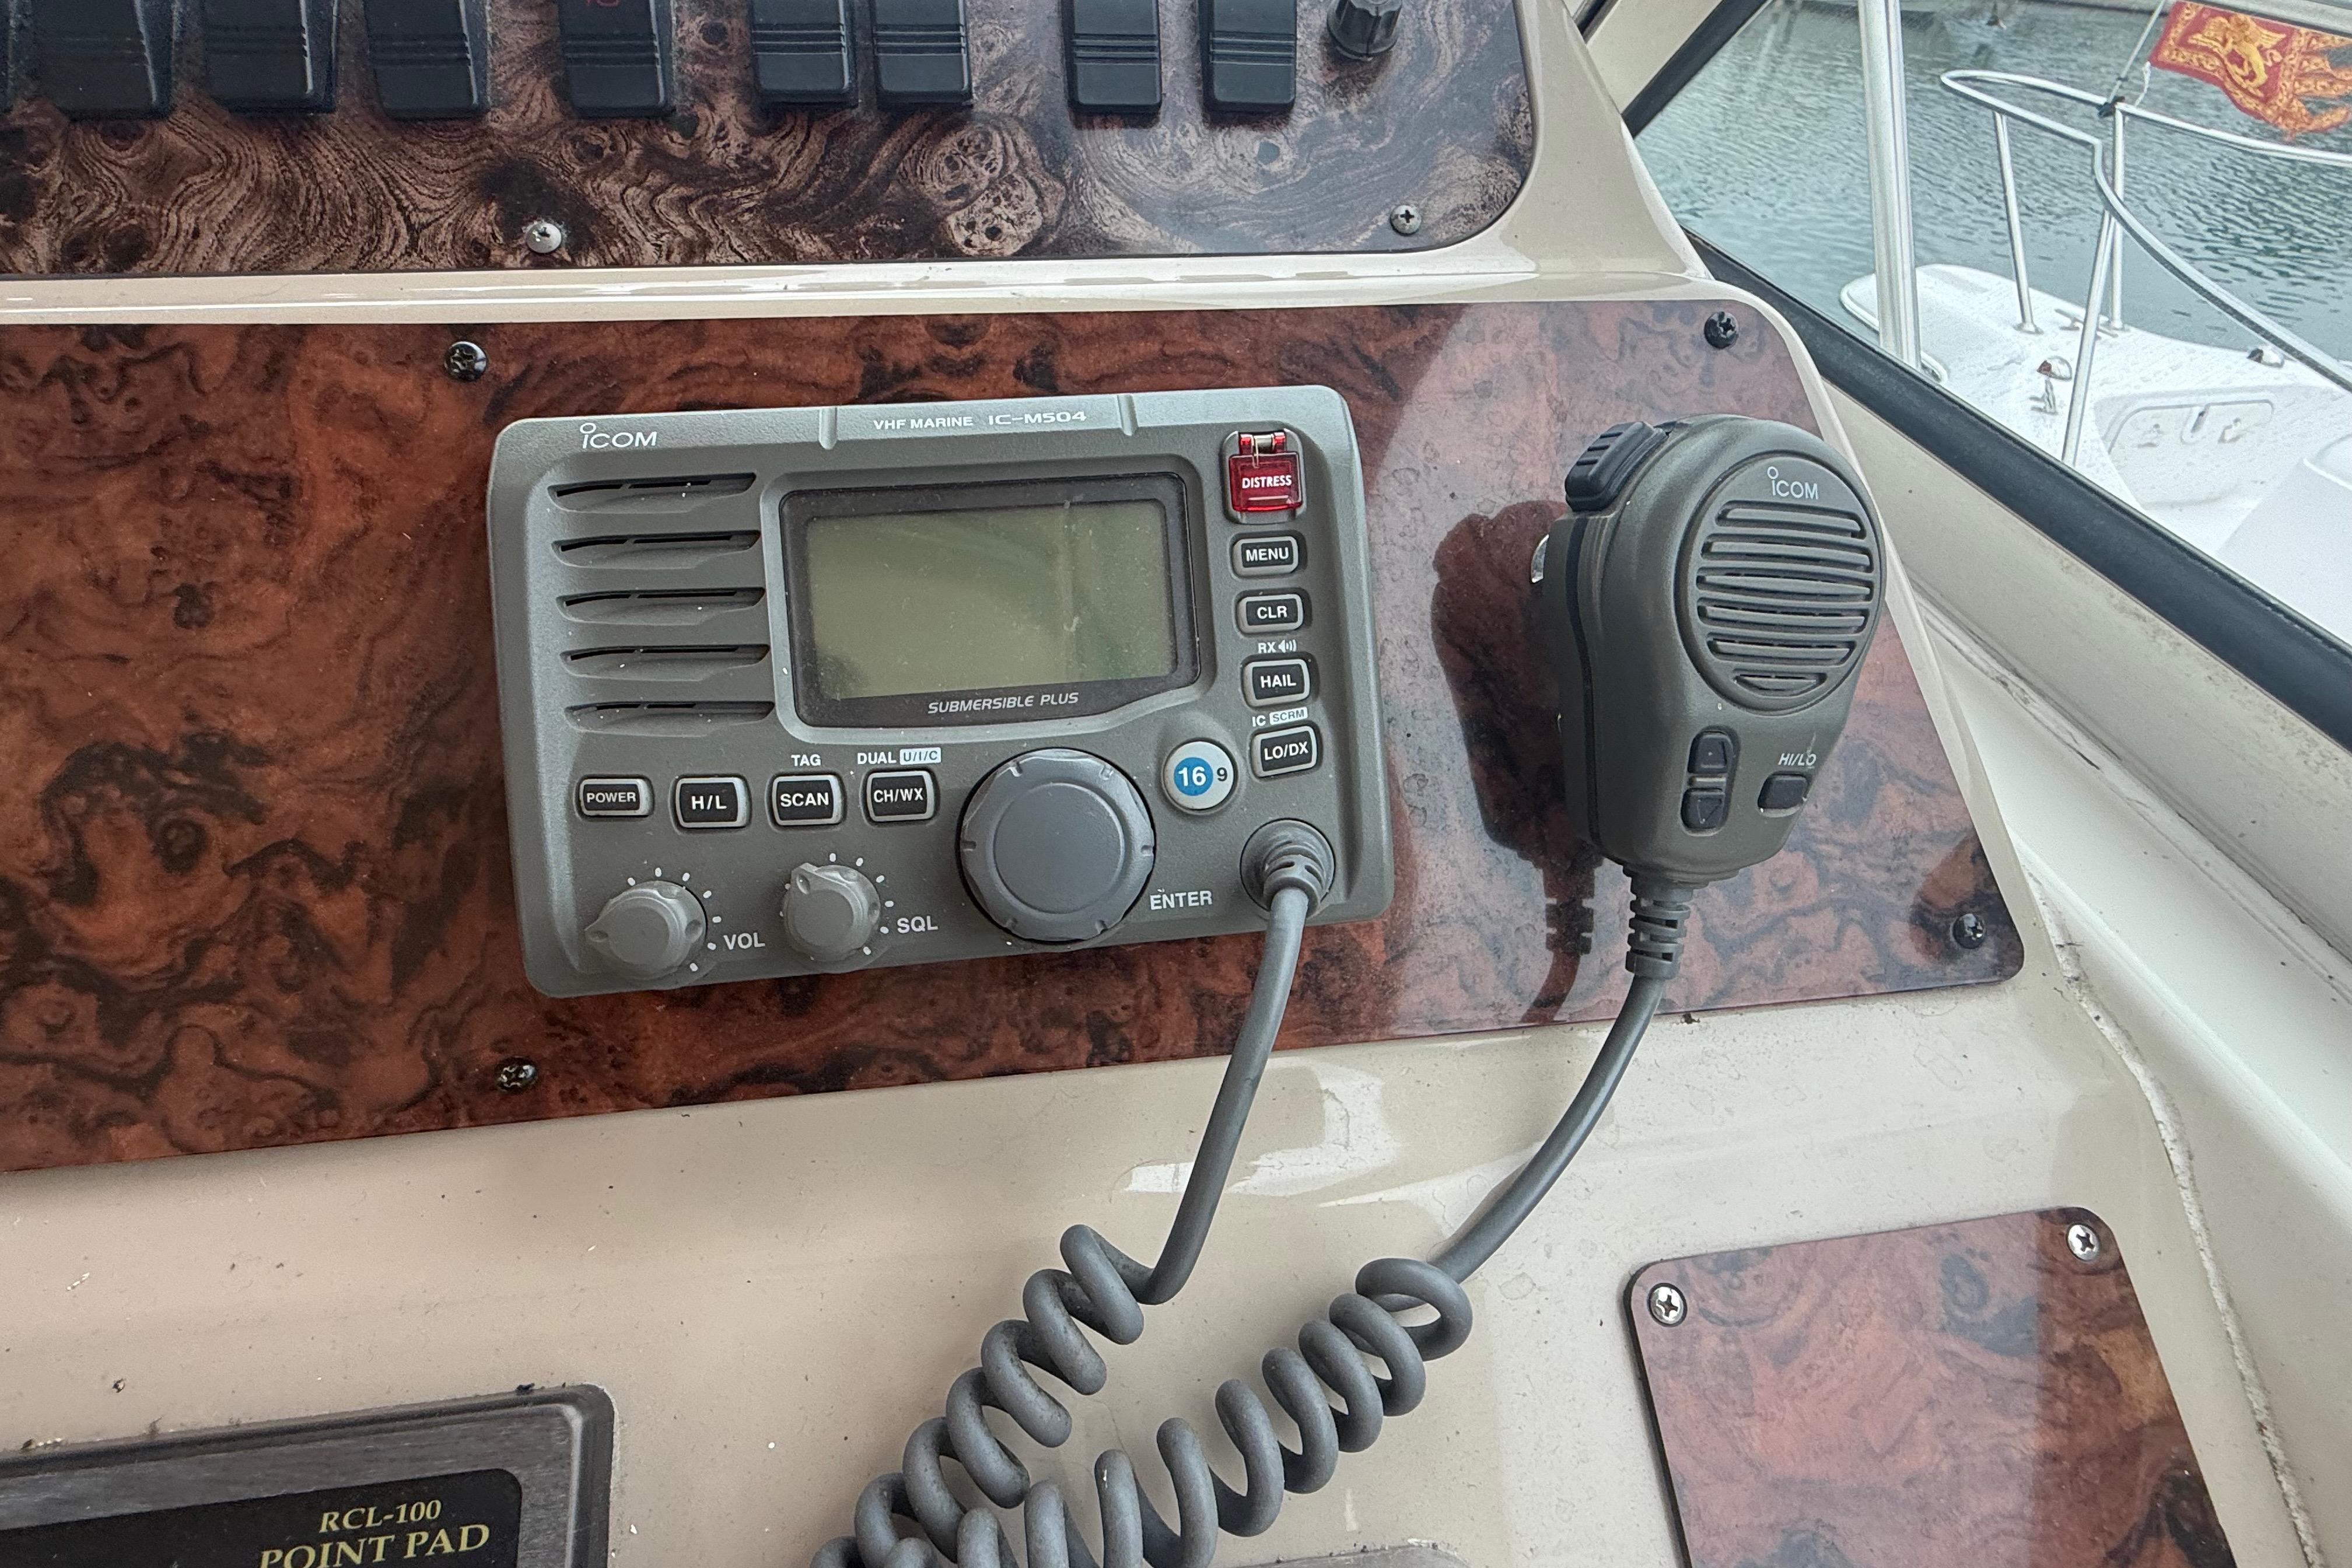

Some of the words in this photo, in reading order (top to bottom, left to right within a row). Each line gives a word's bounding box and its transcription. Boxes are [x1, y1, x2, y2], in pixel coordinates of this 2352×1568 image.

[873, 419, 905, 430] VHF
[910, 416, 974, 429] MARINE
[988, 411, 1087, 426] IC-M504
[1241, 475, 1292, 489] DISTRESS
[1245, 547, 1289, 562] MENU
[1257, 606, 1287, 619] CLR
[1258, 642, 1276, 653] RX
[1260, 674, 1296, 688] HAIL
[928, 695, 1034, 714] SUBMERSIBLE
[1040, 692, 1079, 706] PLUS
[1252, 715, 1266, 727] IC
[1272, 709, 1305, 722] SCRM
[857, 752, 897, 765] DUAL
[903, 750, 939, 762] U/I/C
[1264, 742, 1308, 761] LO/DX
[1778, 752, 1817, 766] HI/LO
[791, 754, 821, 766] TAG
[1178, 766, 1206, 786] 16
[1217, 768, 1228, 782] 9
[586, 792, 636, 803] POWER
[691, 795, 727, 810] H/L
[779, 792, 829, 807] SCAN
[873, 788, 923, 803] CH/WX
[1150, 890, 1213, 911] ENTER
[897, 916, 939, 934] SQL
[723, 933, 765, 951] VOL
[319, 1499, 442, 1534] RCL-100
[260, 1535, 395, 1568] POINT
[404, 1524, 489, 1559] PAD
